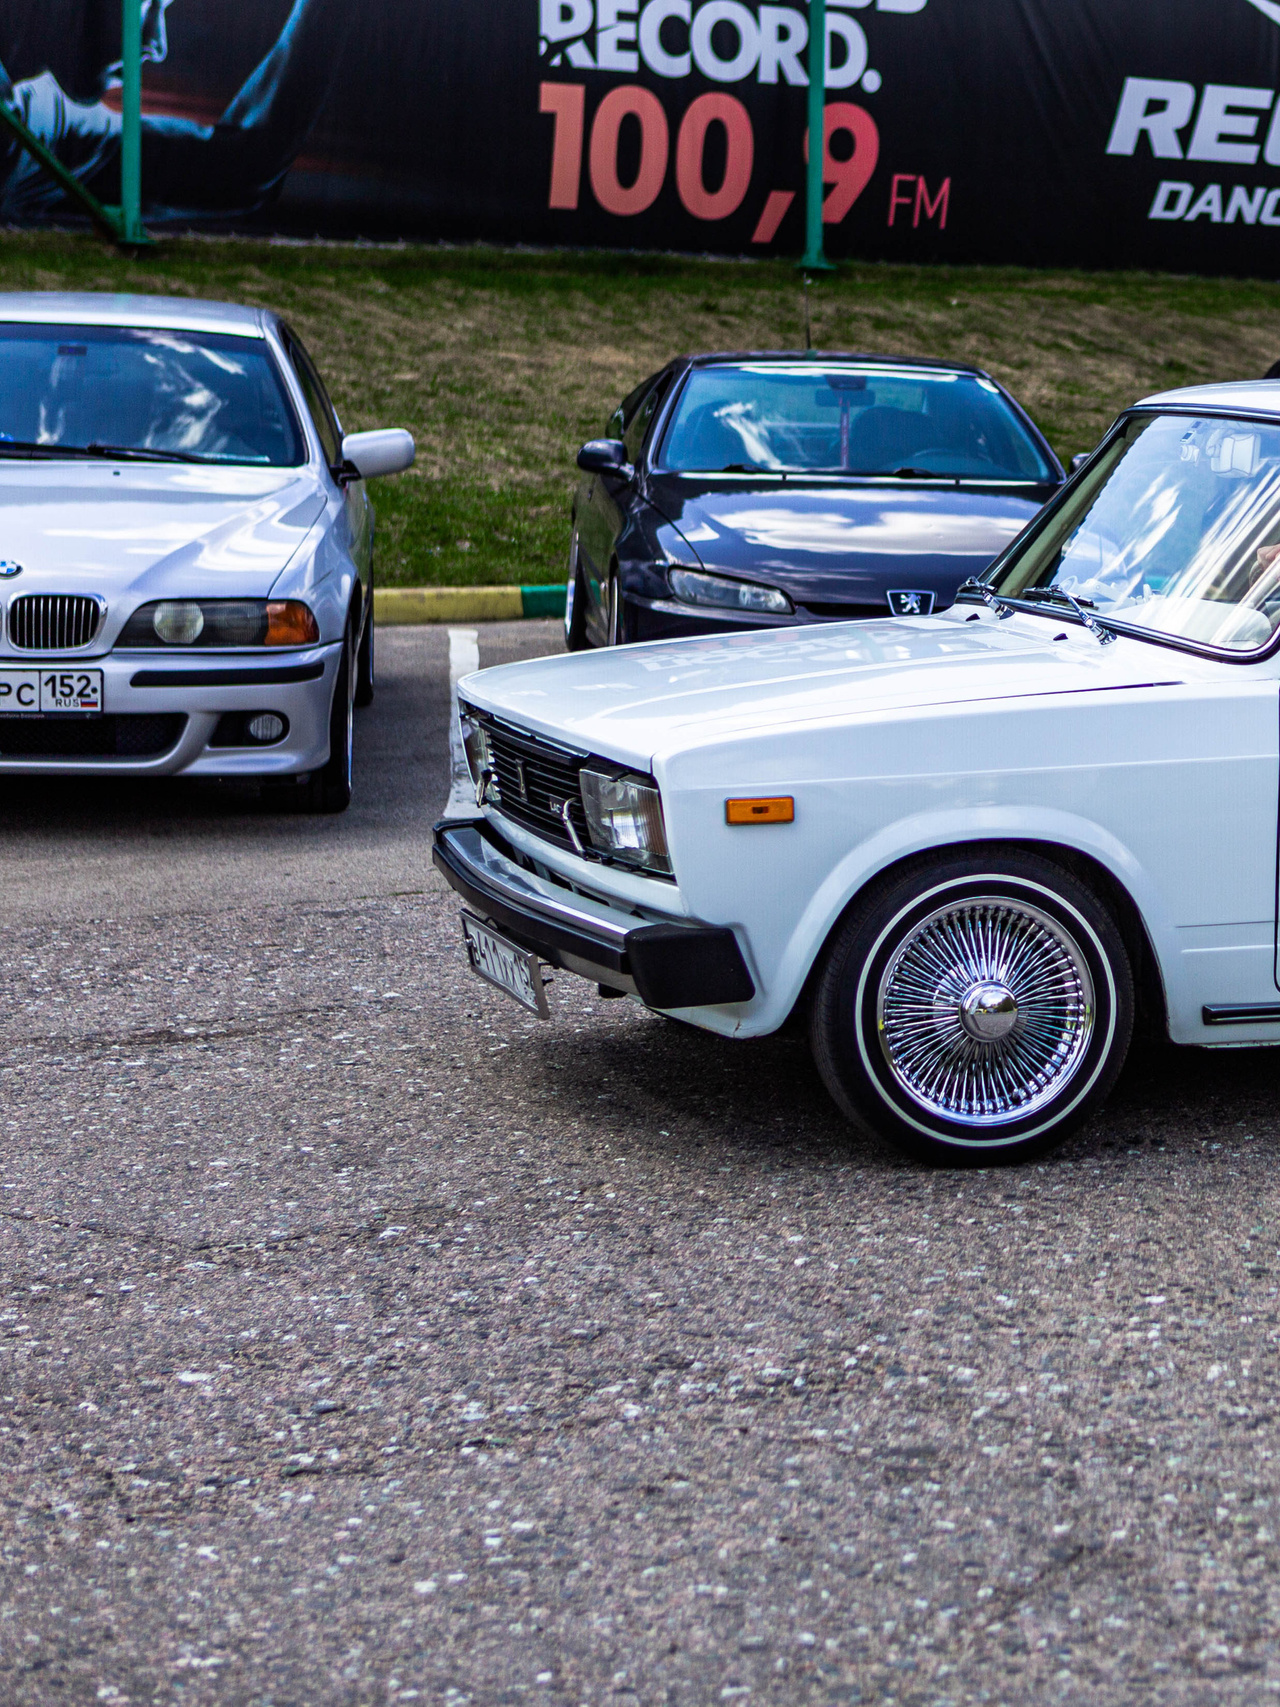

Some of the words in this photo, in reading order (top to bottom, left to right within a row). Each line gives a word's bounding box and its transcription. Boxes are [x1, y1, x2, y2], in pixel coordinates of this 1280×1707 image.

[539, 81, 880, 243] 100,9
[887, 173, 951, 229] FM
[44, 675, 91, 698] 152
[55, 699, 80, 708] RUS
